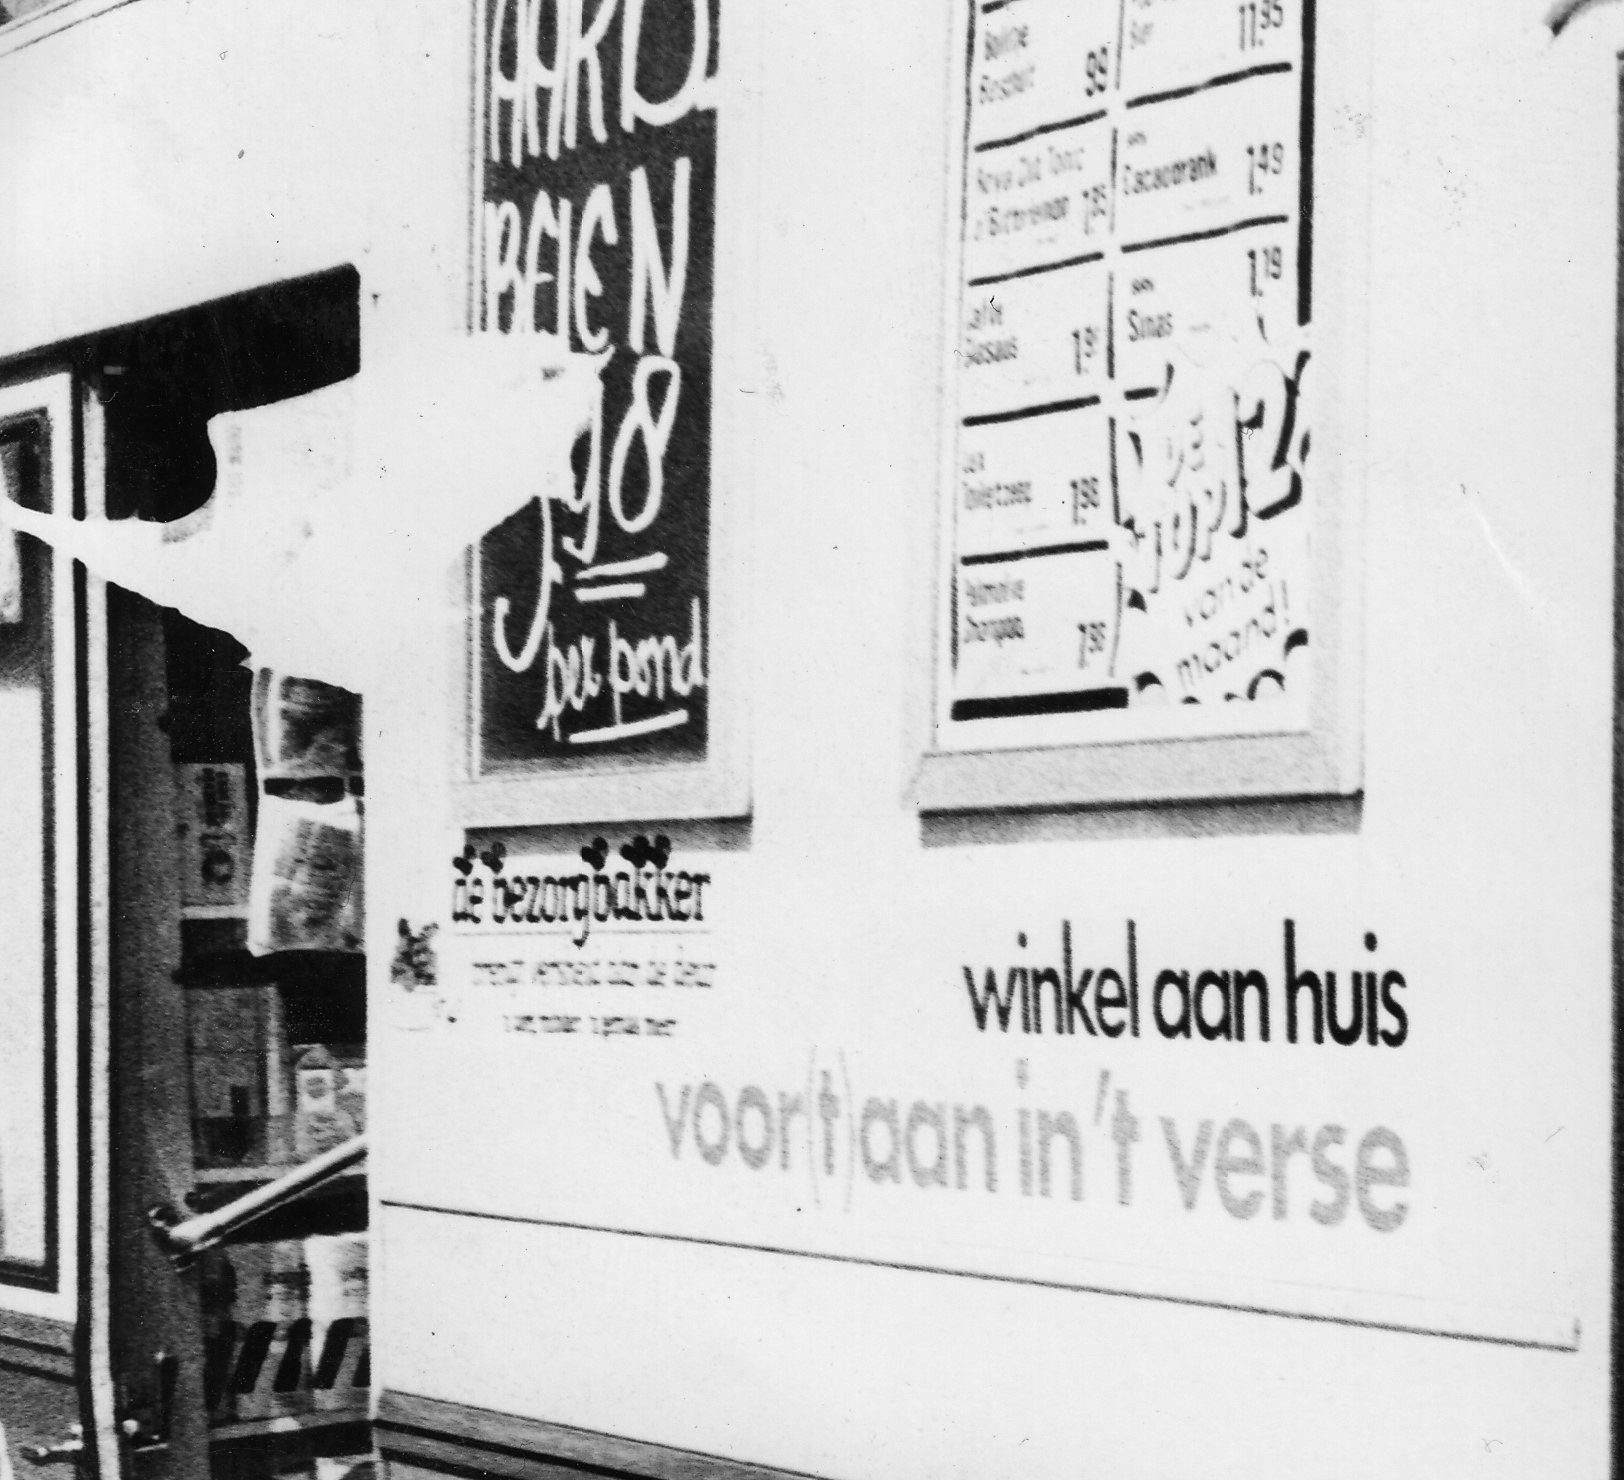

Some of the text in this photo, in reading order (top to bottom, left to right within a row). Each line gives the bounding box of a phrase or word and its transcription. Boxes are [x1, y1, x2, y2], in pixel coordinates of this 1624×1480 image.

[962, 918, 1410, 1047] winkel aan huis
[1159, 1113, 1411, 1233] verse
